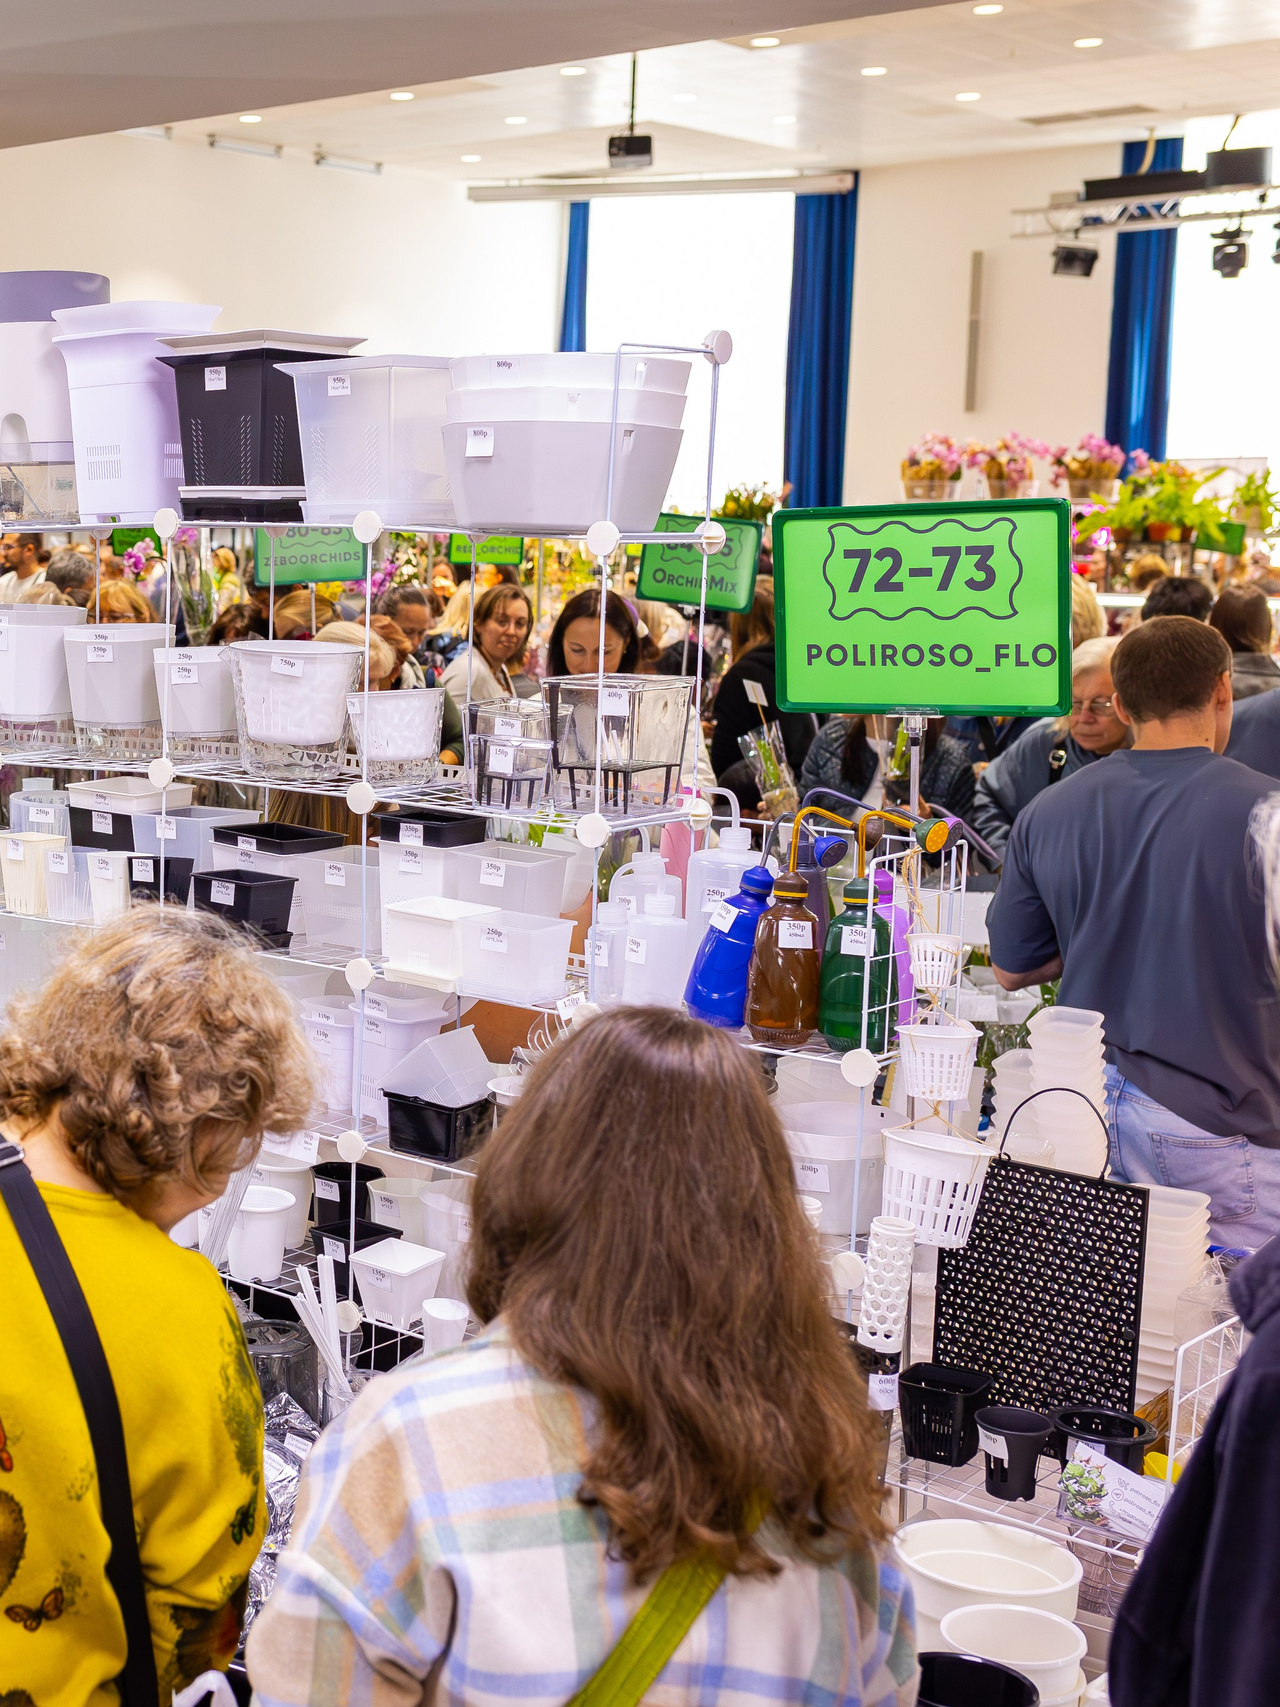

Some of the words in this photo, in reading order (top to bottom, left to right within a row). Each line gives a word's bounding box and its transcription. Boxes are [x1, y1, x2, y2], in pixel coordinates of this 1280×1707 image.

[496, 360, 512, 368] 800р
[473, 430, 487, 438] 800р
[264, 551, 360, 567] ZEBOORCHIDS
[843, 545, 996, 592] 72-73
[807, 643, 1057, 672] POLIROSO_FLO
[280, 659, 295, 668] 750р
[607, 691, 622, 699] 400р
[501, 719, 515, 729] 200р
[495, 748, 508, 757] 150р
[36, 808, 50, 816] 250р
[404, 825, 418, 833] 350р
[52, 853, 63, 861] 120р
[404, 850, 418, 859] 350р
[137, 861, 149, 869] 120р
[328, 864, 341, 872] 450р
[486, 863, 500, 872] 350р
[706, 889, 725, 898] 250р
[787, 923, 806, 932] 350р
[487, 928, 502, 938] 250р
[563, 997, 580, 1008] 170р
[318, 1012, 330, 1021] 110р
[367, 1020, 379, 1028] 160р
[316, 1030, 328, 1039] 110р
[800, 1164, 818, 1174] 400р
[380, 1196, 393, 1205] 150р
[328, 1240, 339, 1249] 135р
[372, 1269, 385, 1278] 135р
